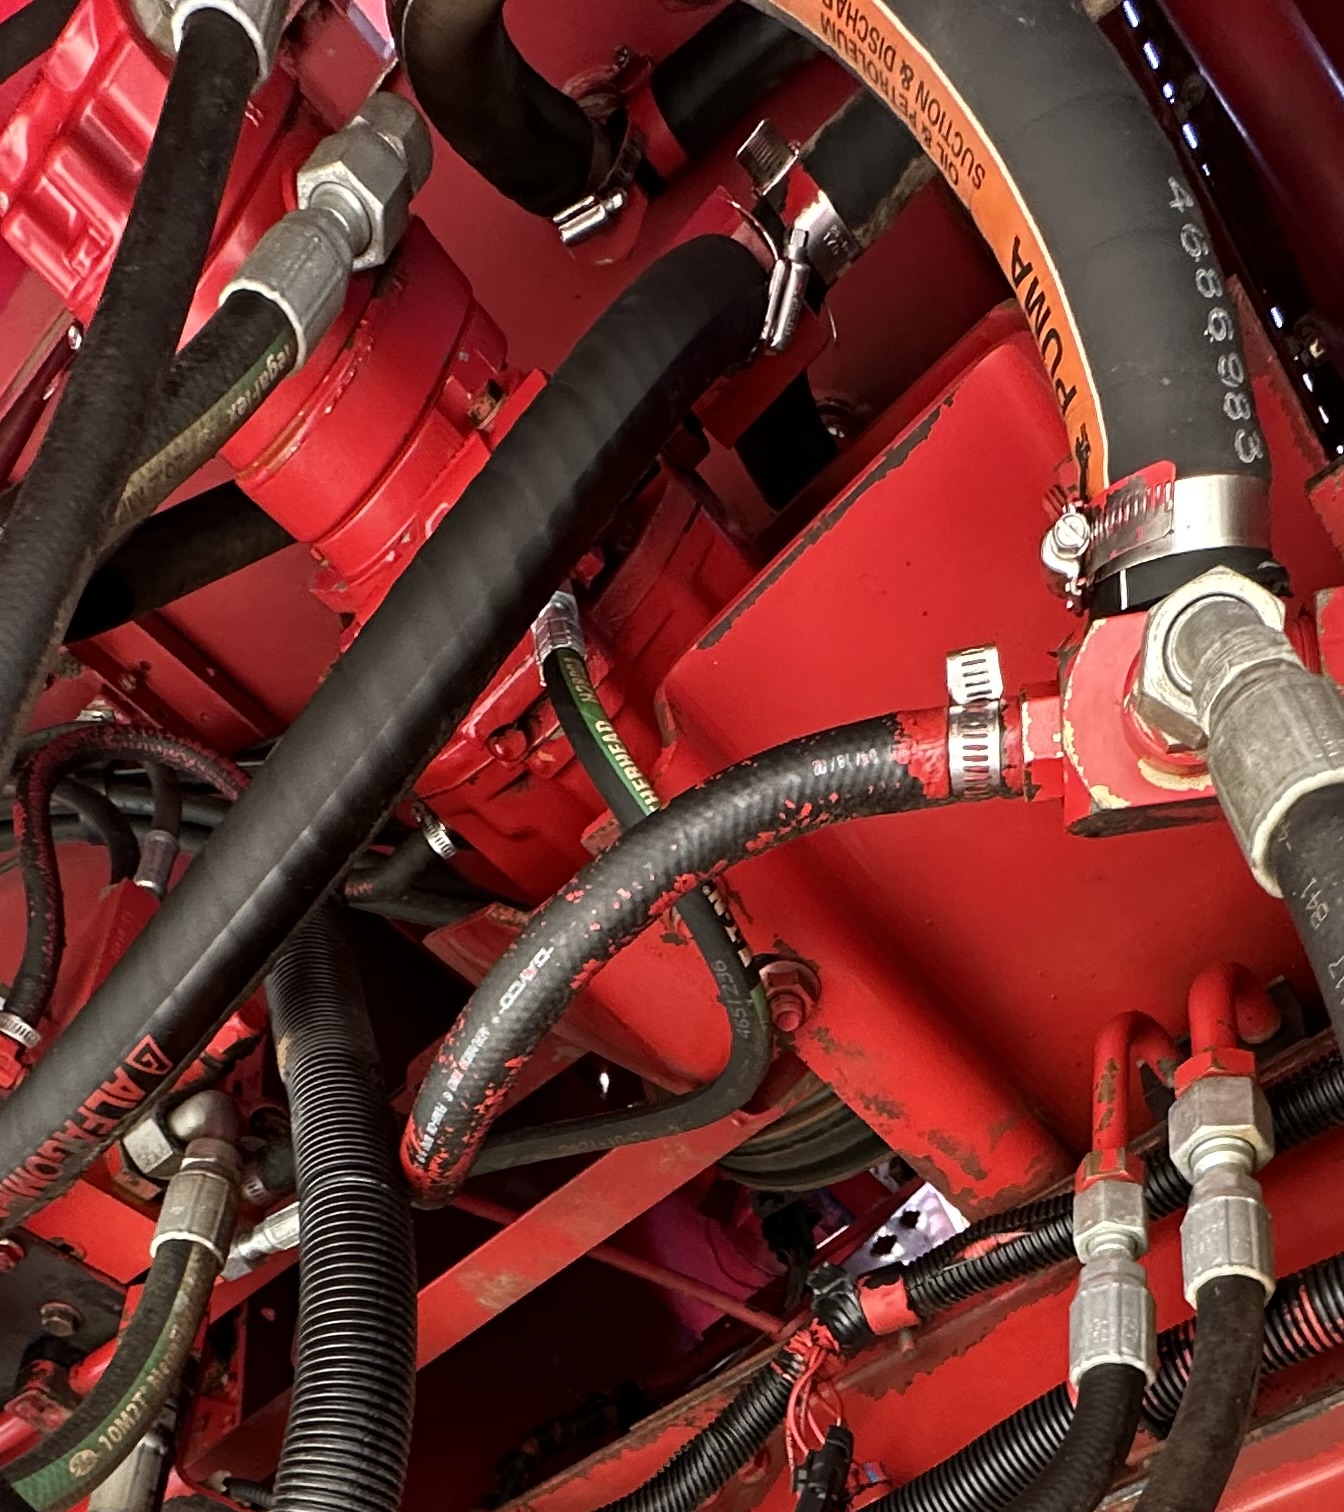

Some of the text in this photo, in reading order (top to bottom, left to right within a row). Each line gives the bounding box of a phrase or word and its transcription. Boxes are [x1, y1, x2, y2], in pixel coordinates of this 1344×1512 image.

[899, 60, 915, 91] &
[914, 80, 986, 190] SUCTION
[920, 123, 933, 149] &
[936, 141, 959, 187] OIL
[1011, 235, 1077, 417] PUMA
[1168, 176, 1263, 463] 4686983
